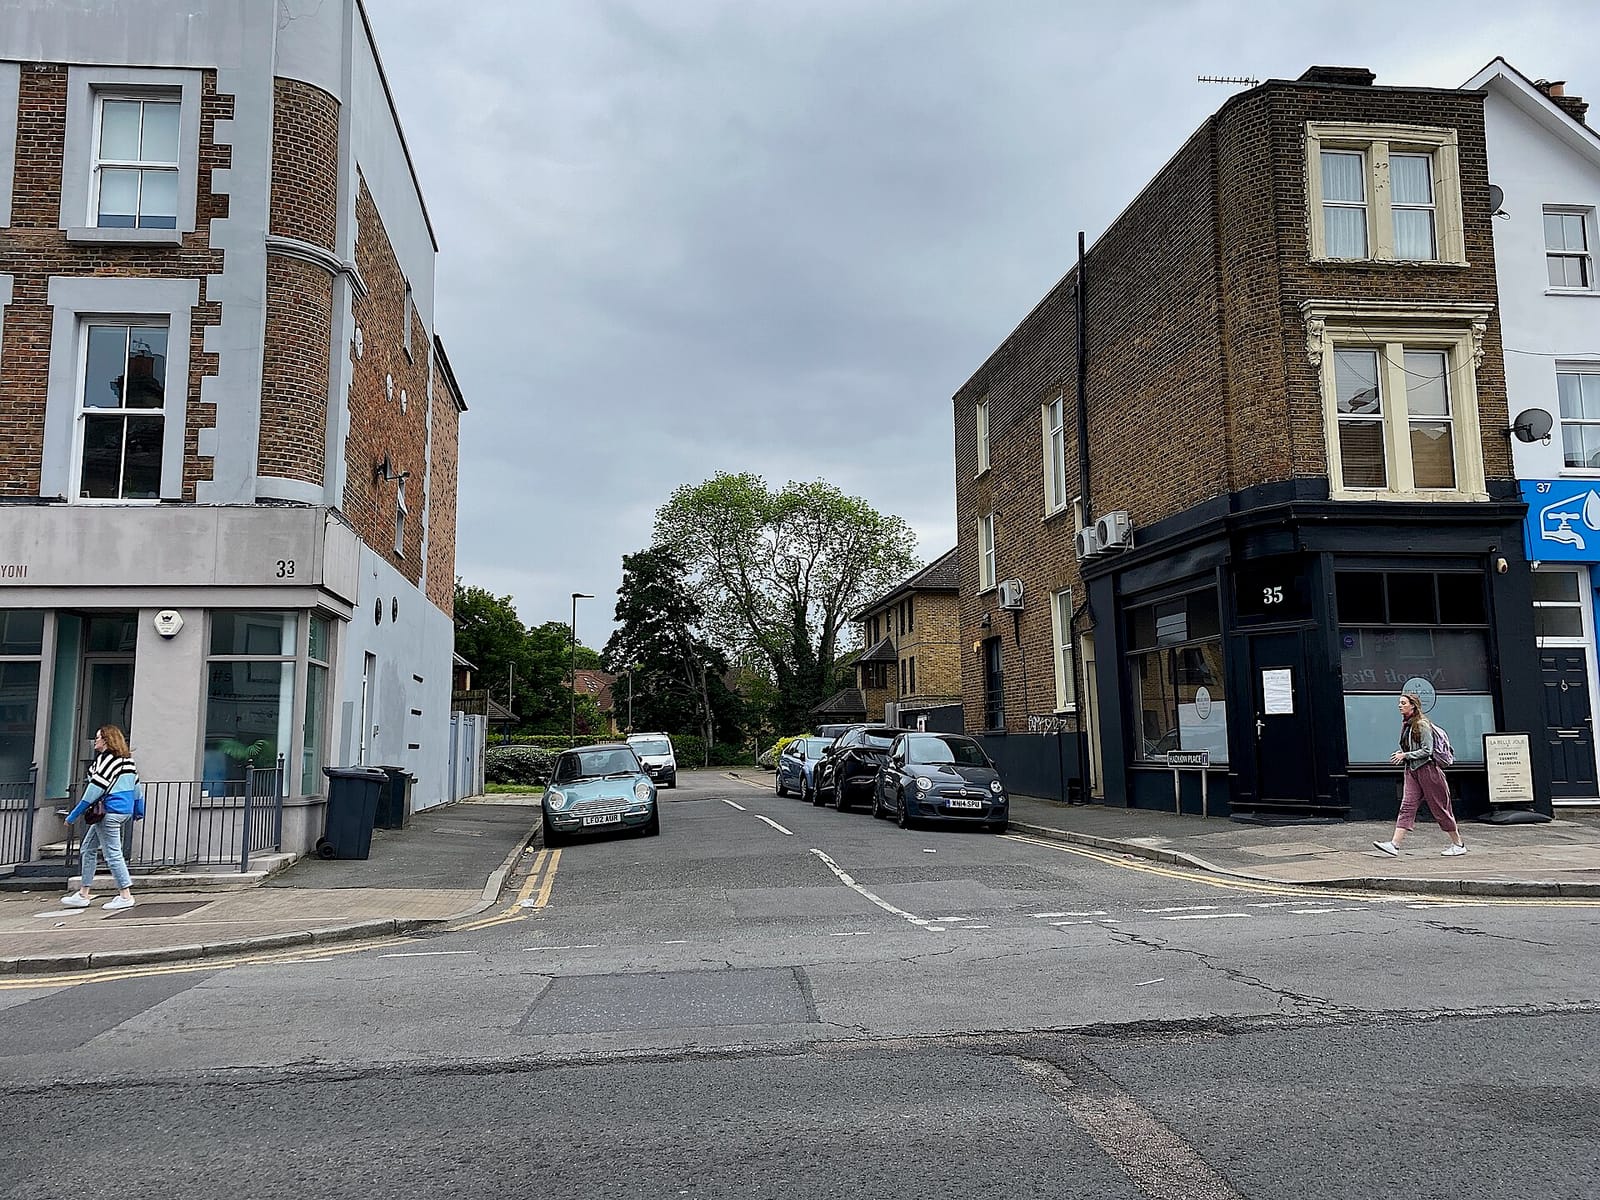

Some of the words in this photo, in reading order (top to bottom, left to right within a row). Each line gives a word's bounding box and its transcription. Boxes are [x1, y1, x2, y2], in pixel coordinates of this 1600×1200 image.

[1536, 482, 1552, 494] 37
[1, 565, 28, 578] YONI
[276, 560, 295, 578] 33
[1263, 586, 1283, 604] 35
[1187, 754, 1202, 764] PLACE
